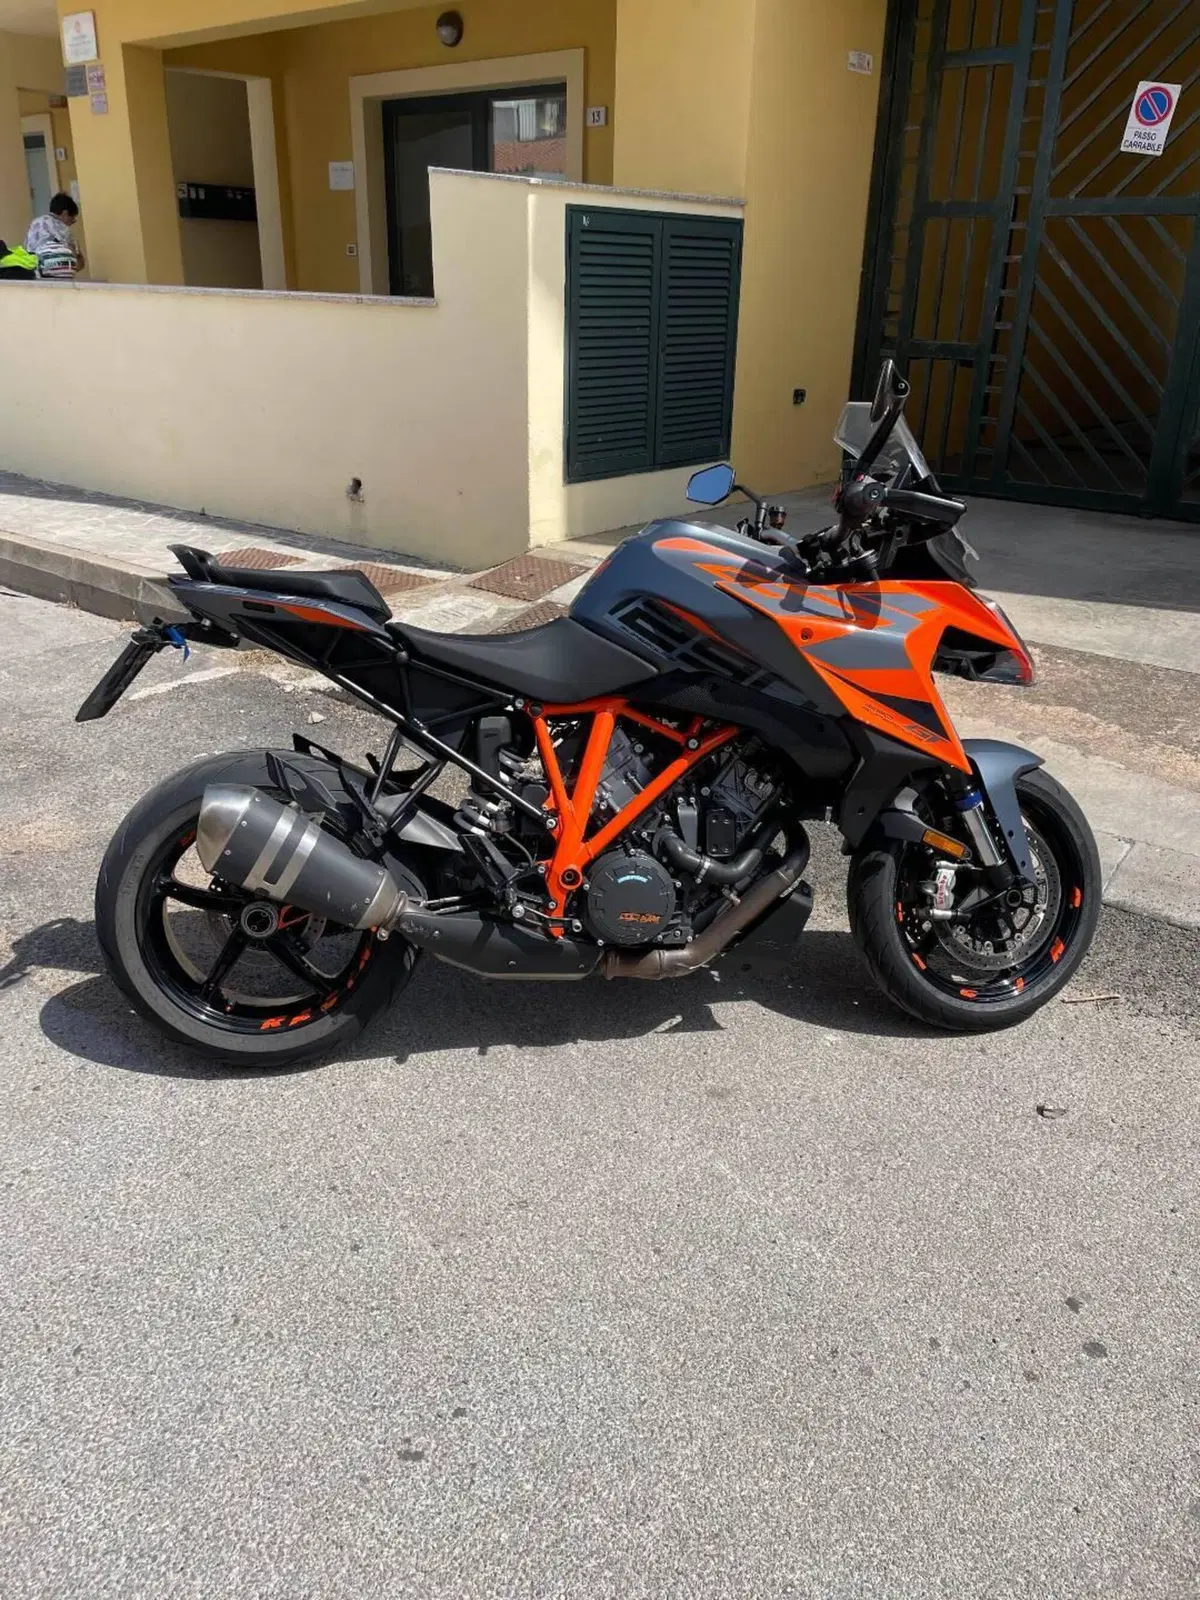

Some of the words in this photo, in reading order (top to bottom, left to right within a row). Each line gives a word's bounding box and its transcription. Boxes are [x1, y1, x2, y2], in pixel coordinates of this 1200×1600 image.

[592, 110, 601, 124] 13
[1134, 131, 1157, 141] PASSO
[1123, 140, 1162, 151] CARRABILE
[938, 875, 947, 904] brembo
